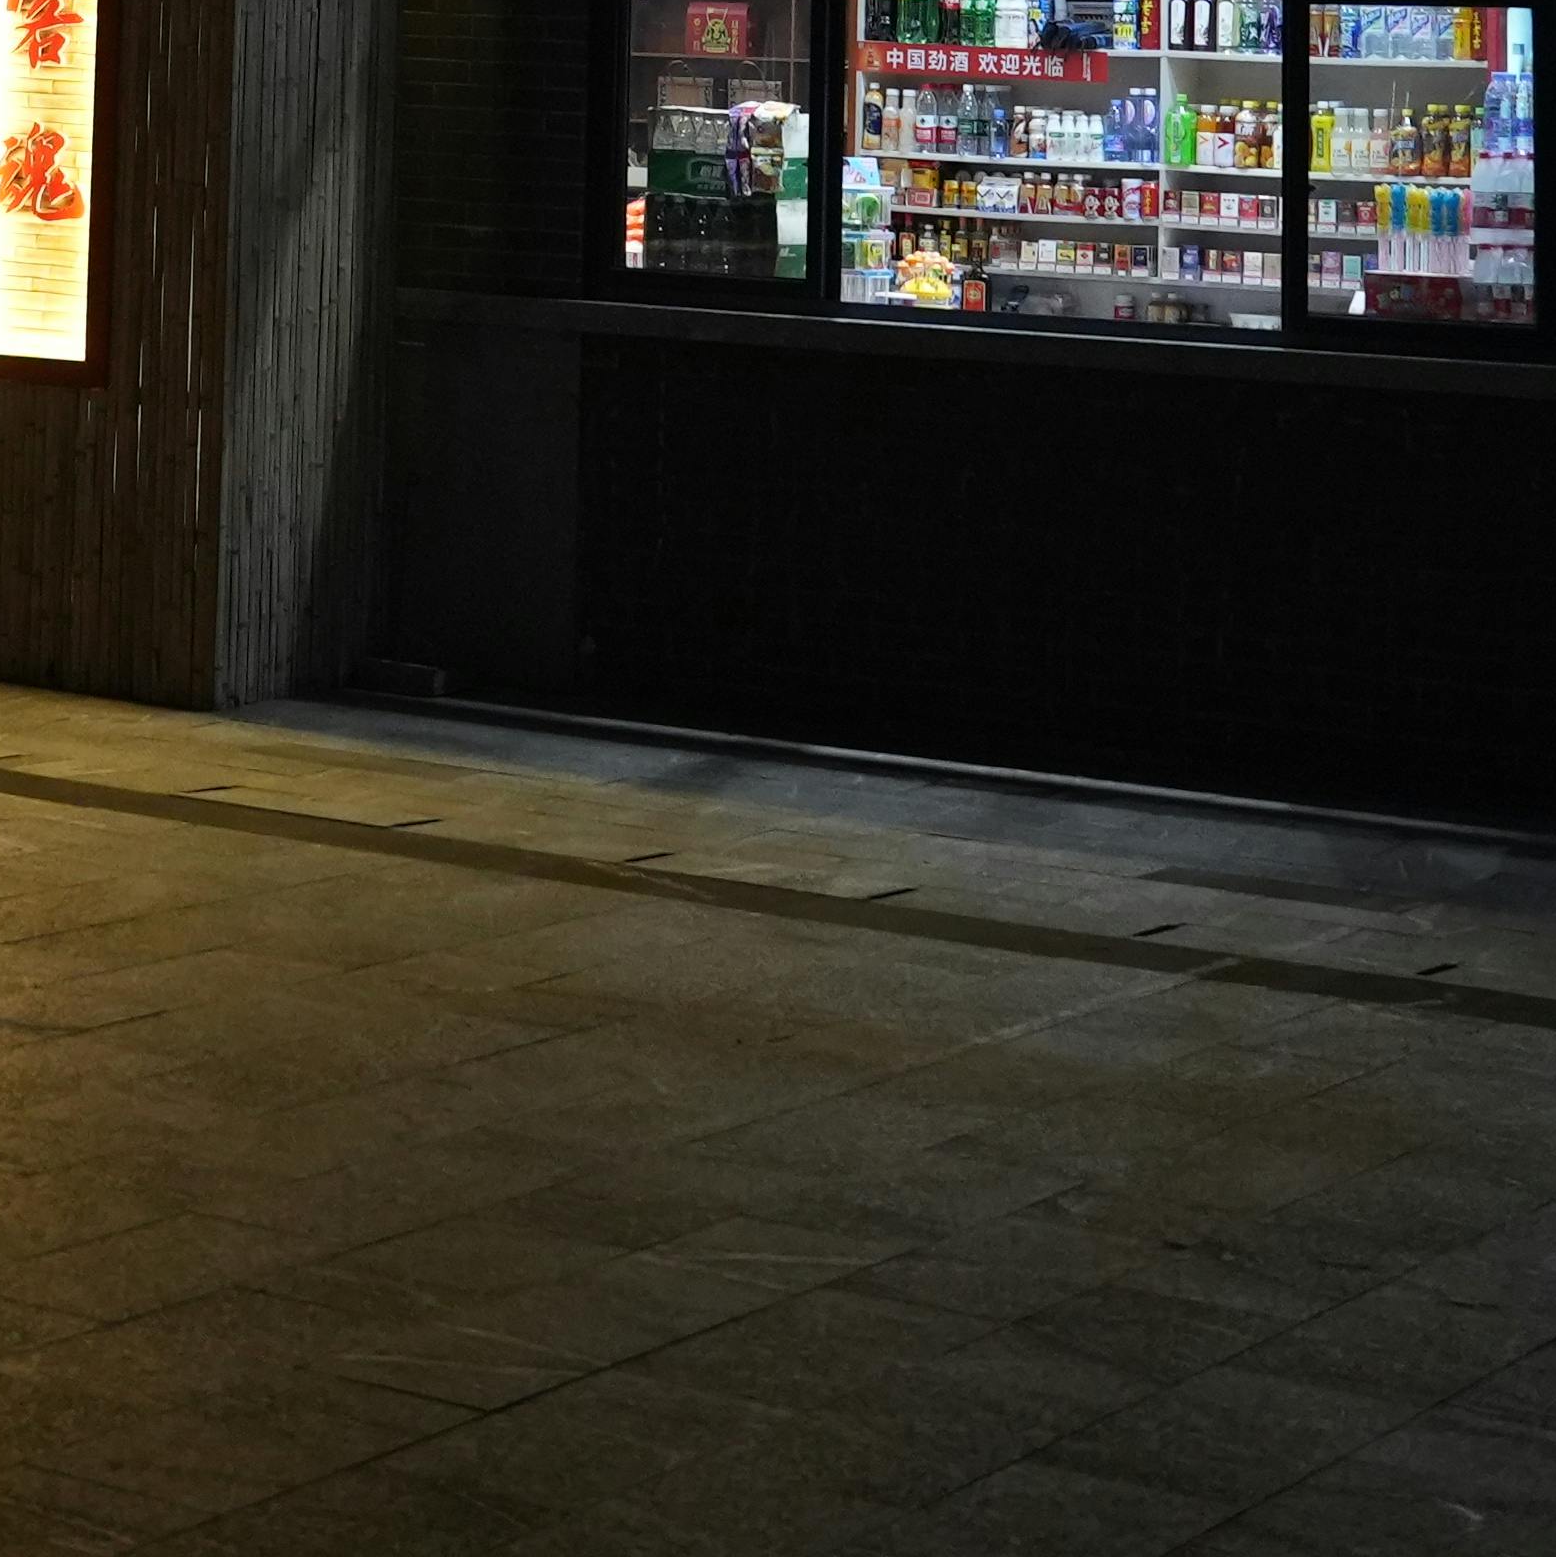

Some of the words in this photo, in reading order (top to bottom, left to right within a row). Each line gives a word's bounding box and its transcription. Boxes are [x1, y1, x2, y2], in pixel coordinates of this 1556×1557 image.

[886, 47, 970, 73] 中国劲酒
[978, 53, 1065, 79] 欢迎光临
